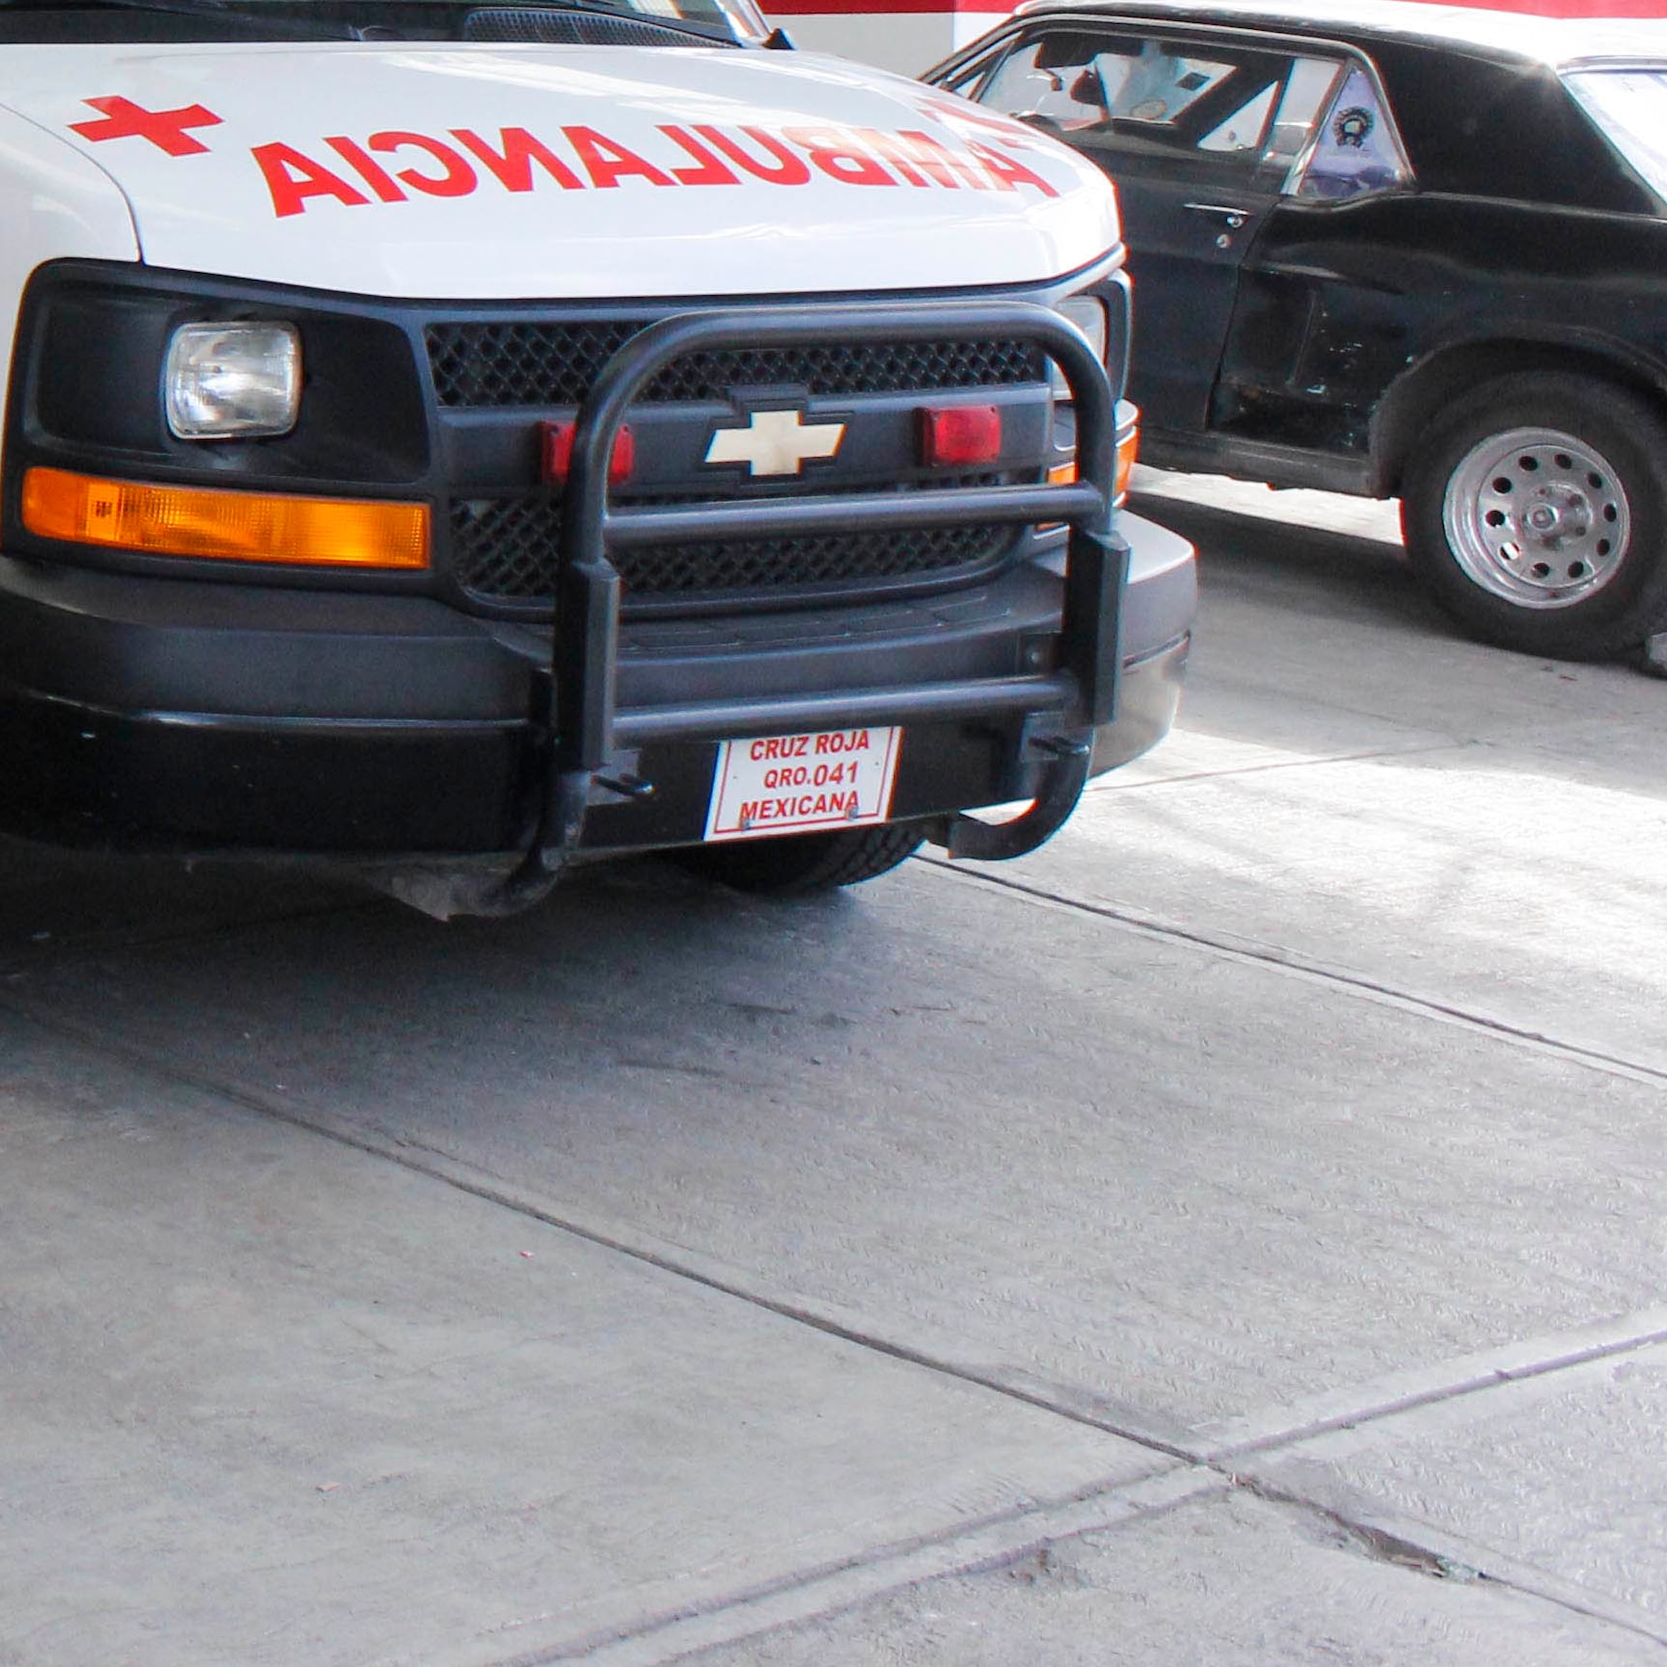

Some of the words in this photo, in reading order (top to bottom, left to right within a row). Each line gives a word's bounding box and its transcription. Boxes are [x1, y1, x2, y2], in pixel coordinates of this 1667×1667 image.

[750, 736, 809, 760] CRUZ
[815, 730, 869, 754] ROJA
[764, 761, 858, 788] QRO.041
[739, 790, 859, 822] MEXICANA
